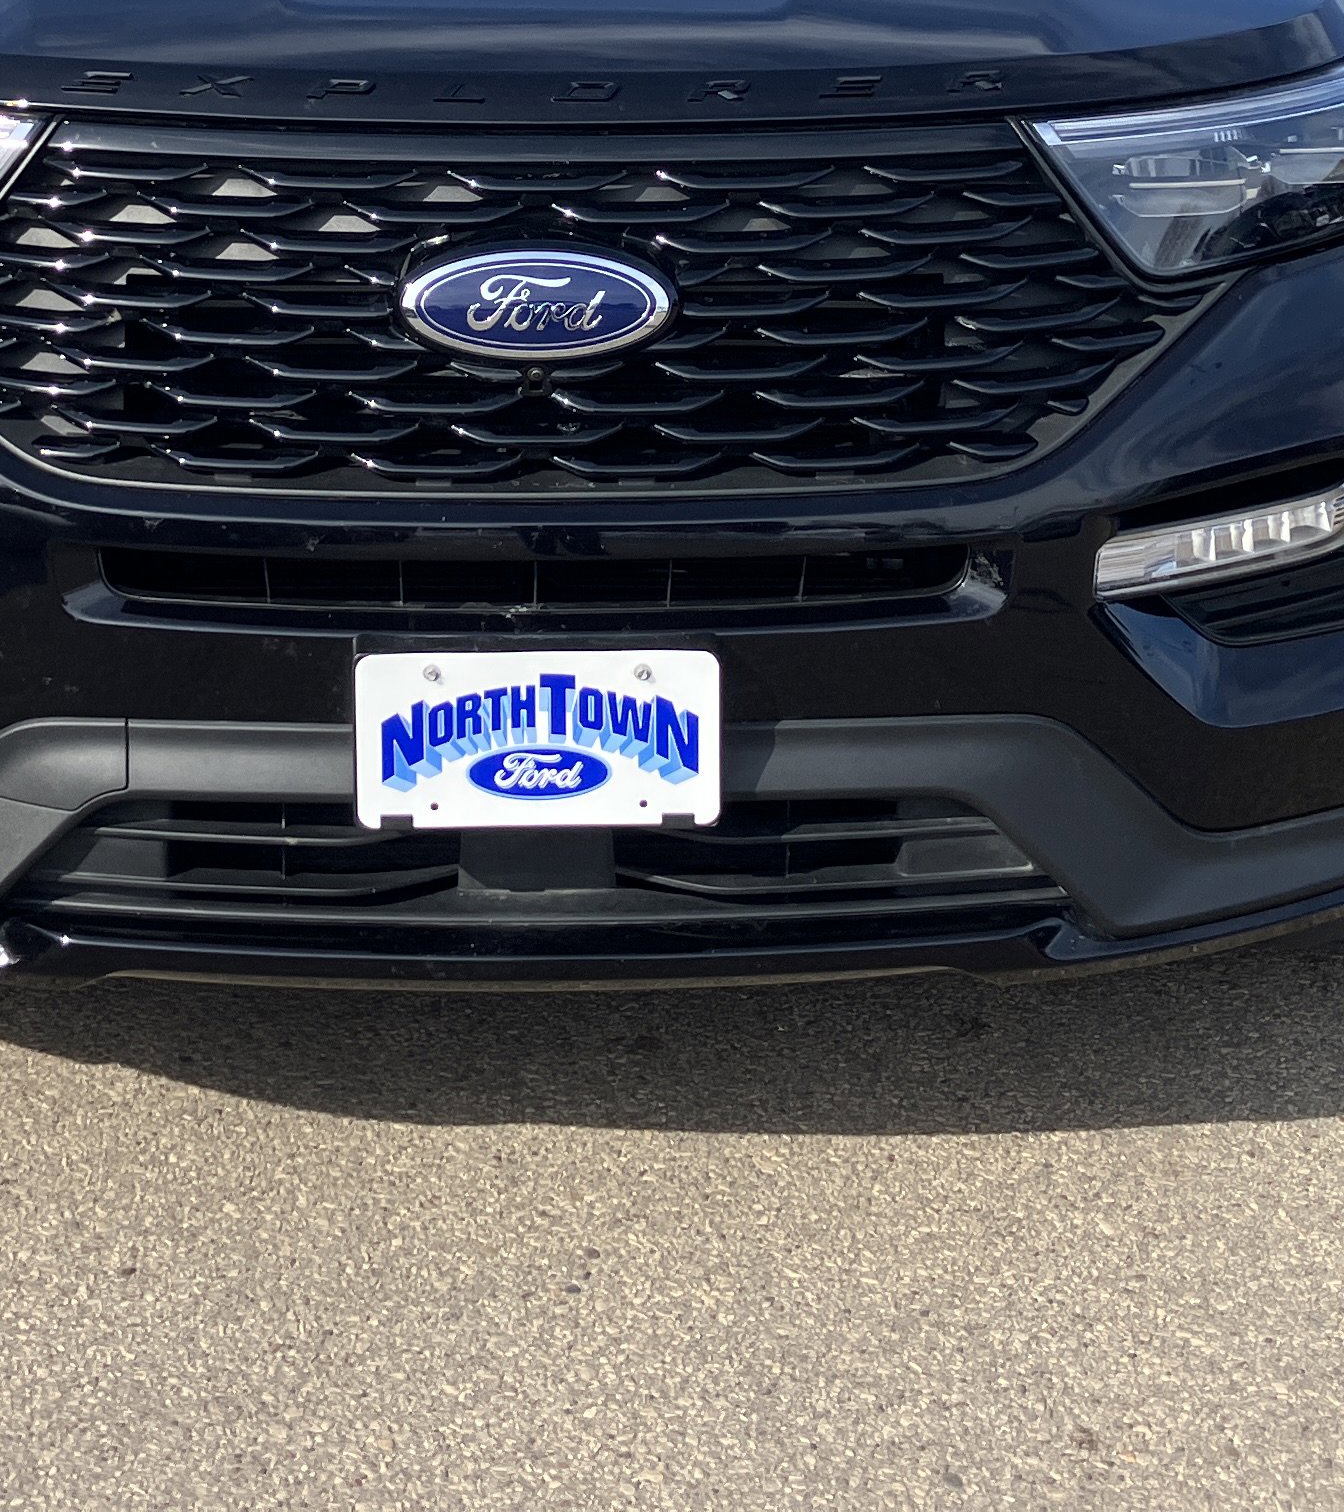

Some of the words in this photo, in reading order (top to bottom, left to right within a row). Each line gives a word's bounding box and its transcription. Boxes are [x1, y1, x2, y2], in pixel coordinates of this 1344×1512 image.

[60, 70, 1003, 104] EXPLORER
[466, 274, 606, 331] Ford
[494, 752, 585, 789] Ford
